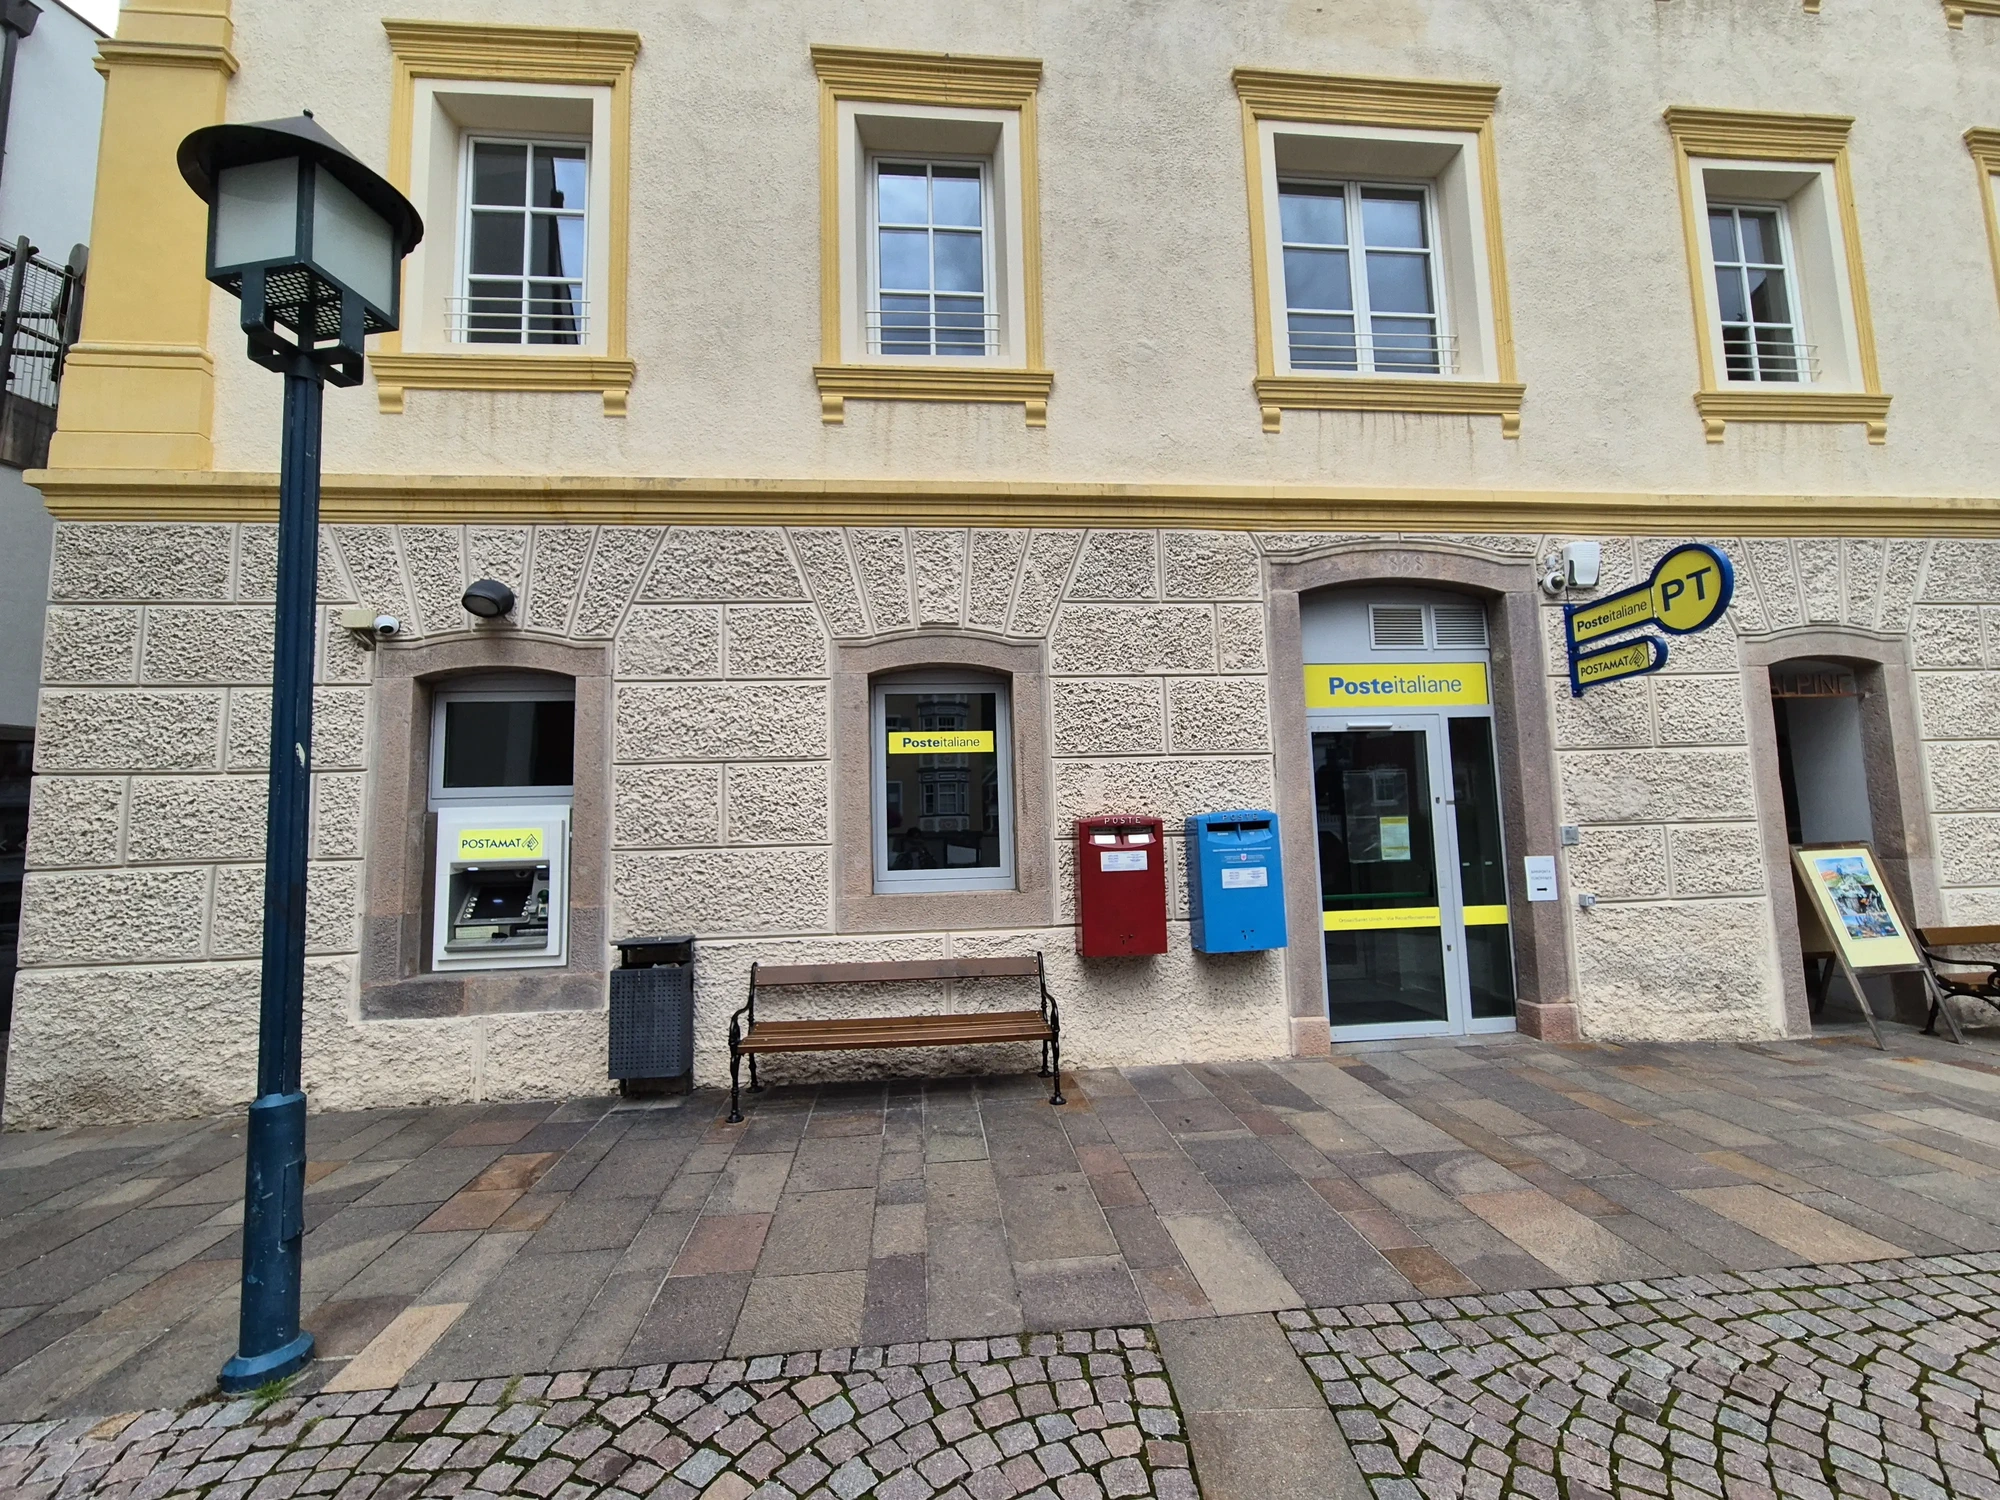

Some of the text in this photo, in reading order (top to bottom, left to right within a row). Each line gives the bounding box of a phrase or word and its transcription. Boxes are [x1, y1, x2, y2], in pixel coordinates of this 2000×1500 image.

[1661, 566, 1712, 612] PT
[1576, 600, 1648, 633] Posteitaliane
[1580, 655, 1630, 677] POSTAMAT
[1328, 675, 1462, 695] Posteitaliane
[902, 736, 980, 748] Posteitaliane
[1104, 816, 1141, 825] POSTE
[1222, 813, 1259, 821] POSTE
[461, 838, 522, 849] POSTAMAT
